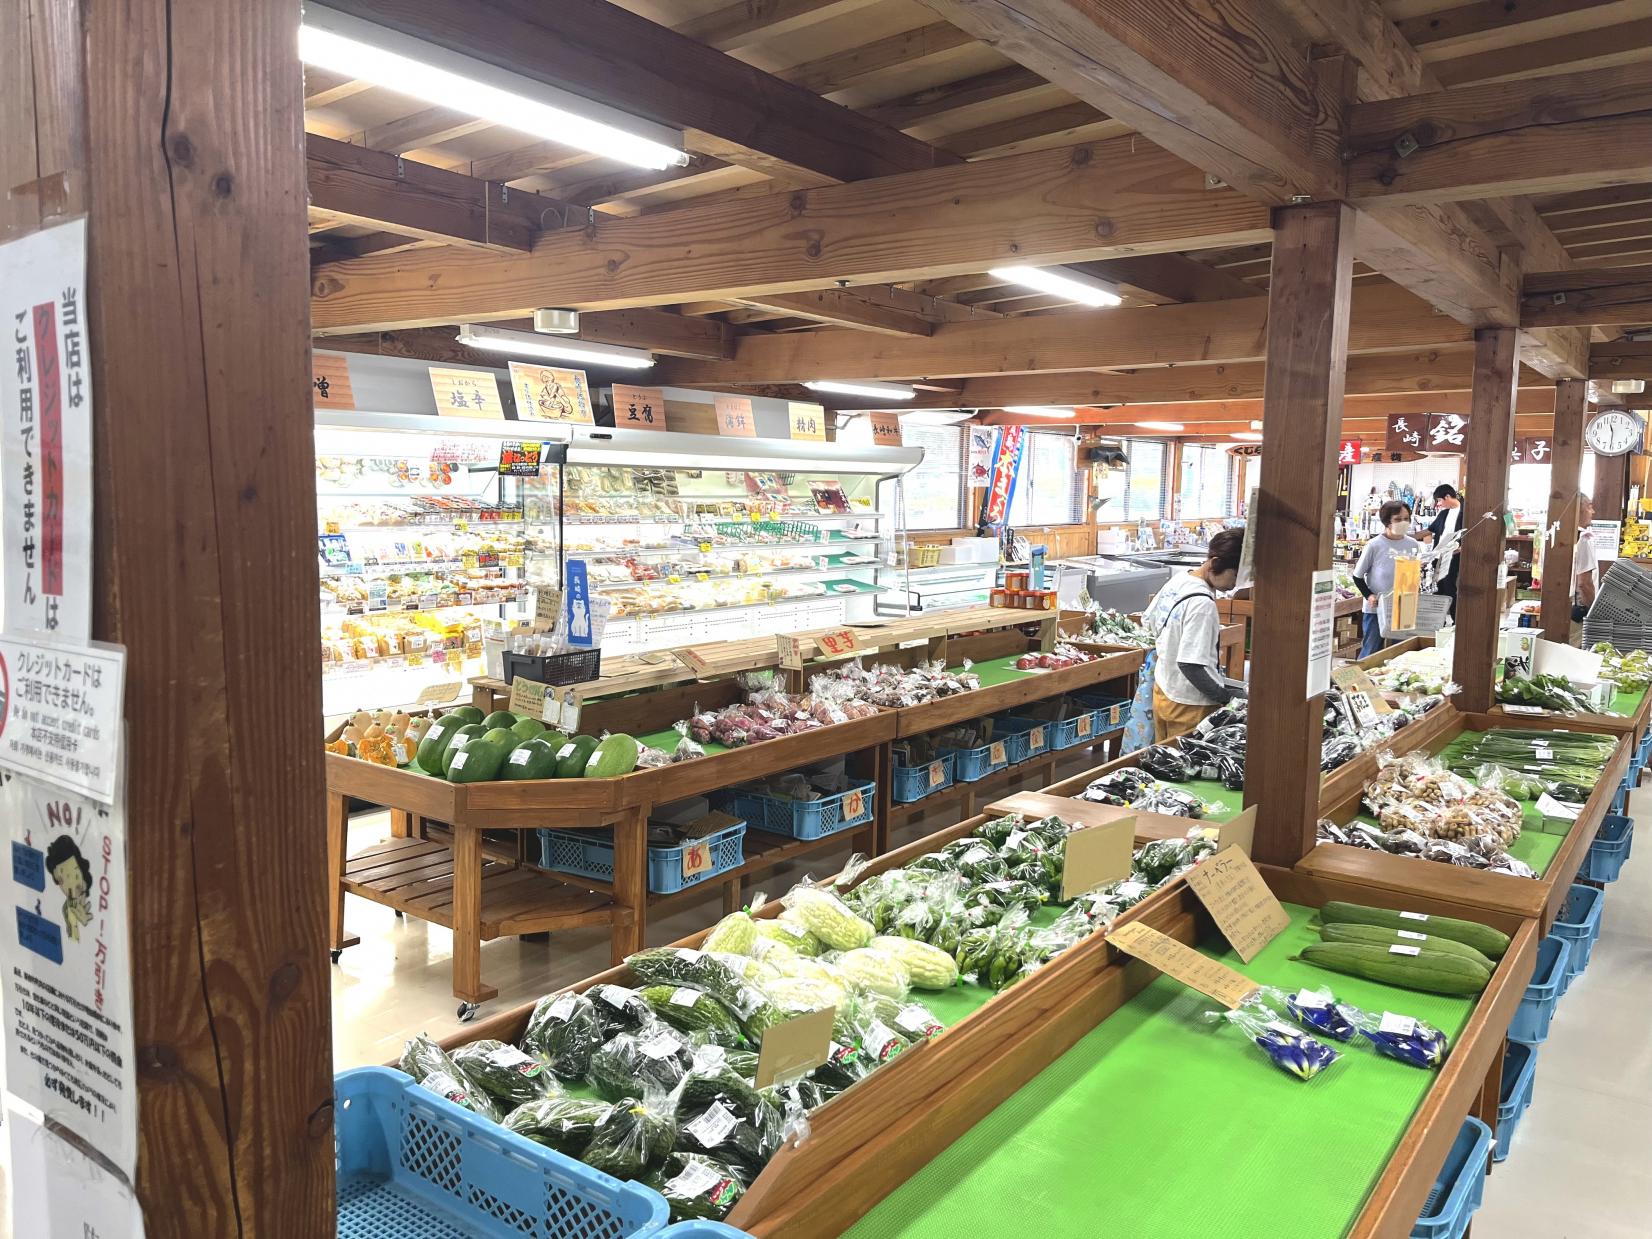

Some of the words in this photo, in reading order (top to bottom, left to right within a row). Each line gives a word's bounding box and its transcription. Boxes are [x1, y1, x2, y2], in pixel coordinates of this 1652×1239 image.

[62, 286, 84, 409] 当店は
[450, 390, 486, 411] 塩辛
[627, 403, 655, 425] 豆腐
[796, 417, 817, 434] 精肉
[14, 310, 37, 605] ご利用できません
[37, 307, 60, 631] クレジットカードは
[17, 651, 103, 689] クレジットカードは
[15, 676, 95, 717] ご利用できません。
